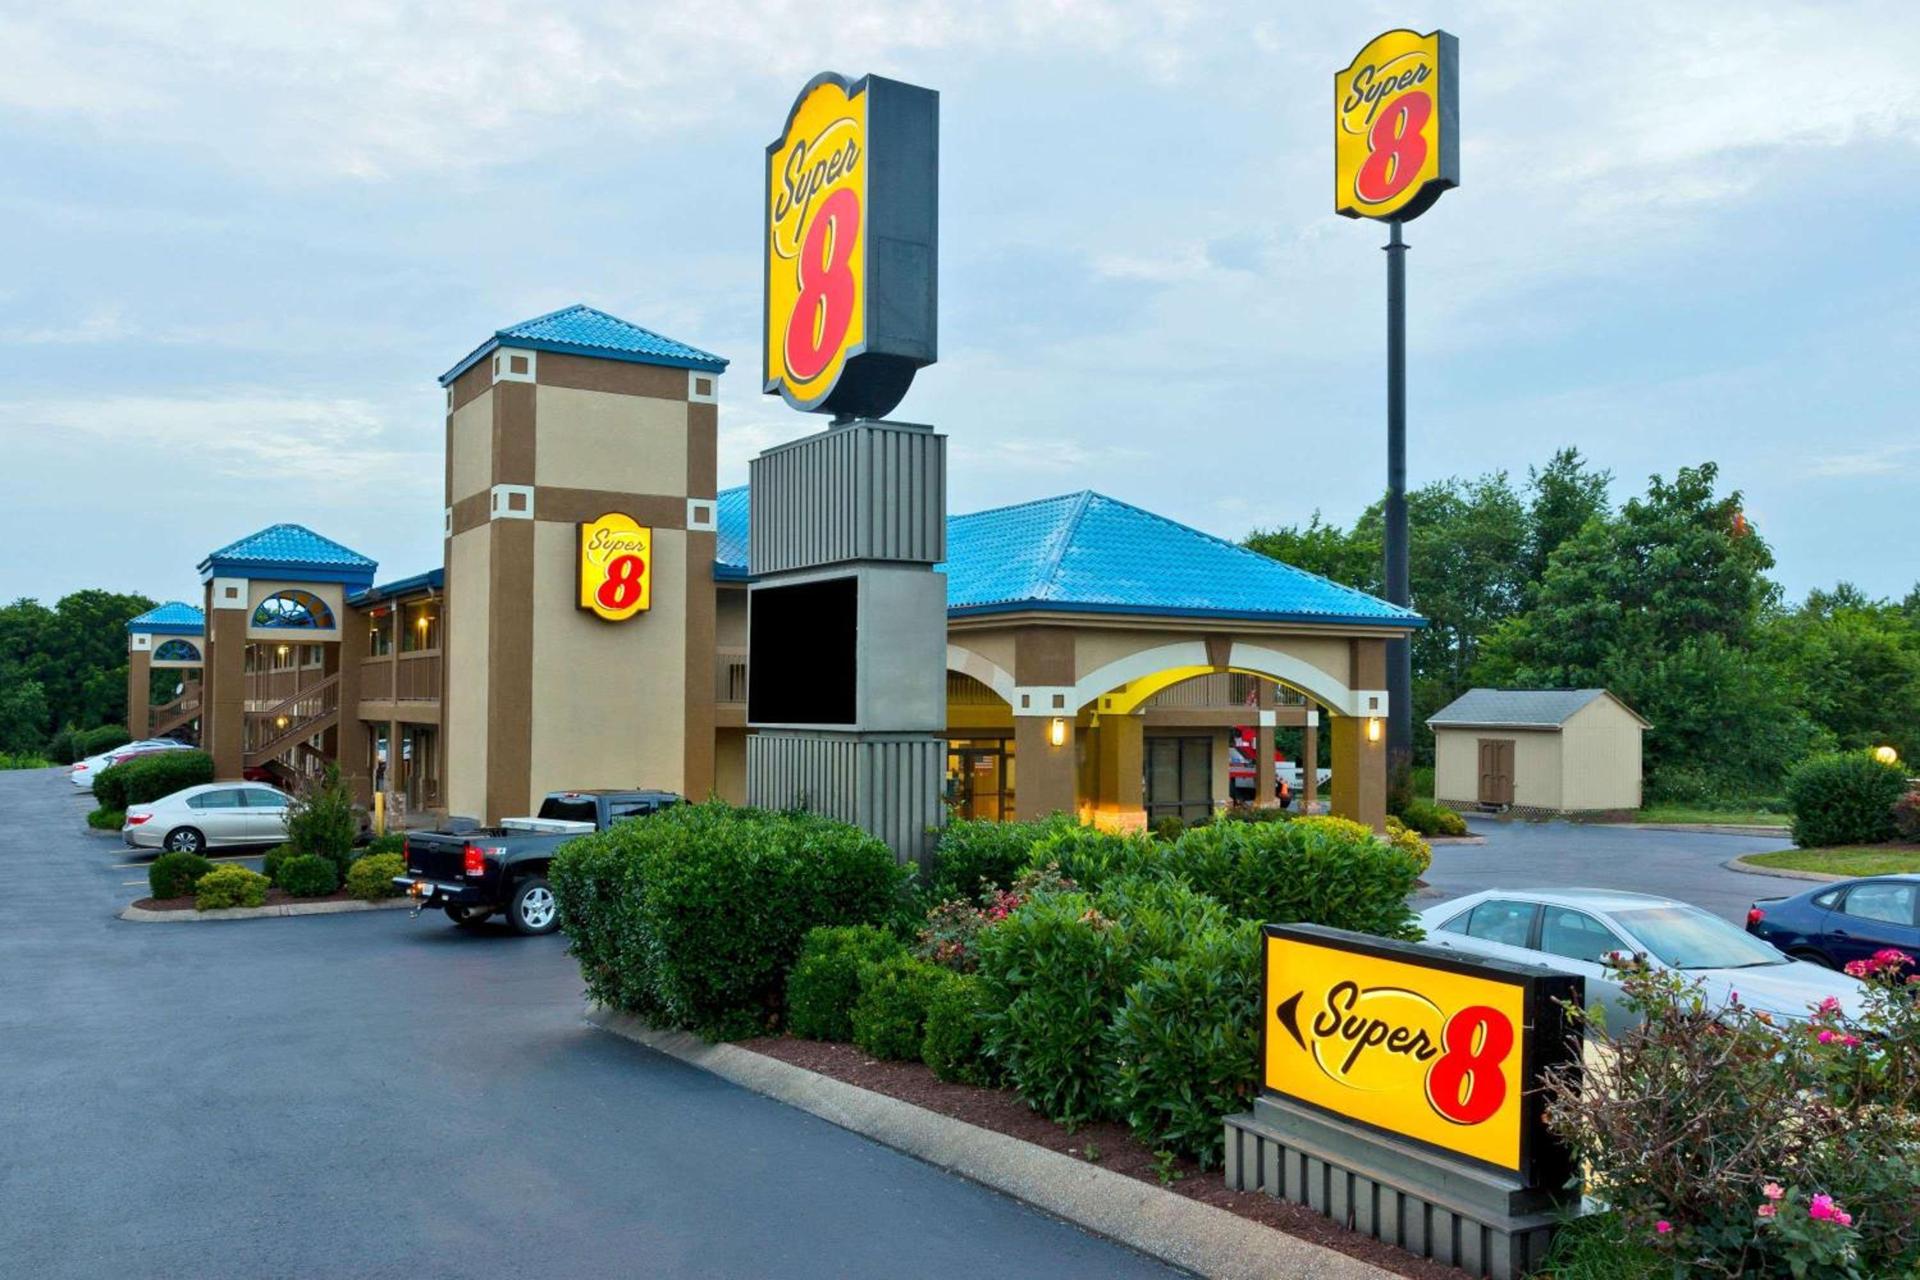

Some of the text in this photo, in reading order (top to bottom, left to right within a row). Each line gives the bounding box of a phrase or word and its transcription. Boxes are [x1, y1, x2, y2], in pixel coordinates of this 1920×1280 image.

[1343, 62, 1433, 125] Super
[774, 137, 860, 244] Super
[1354, 91, 1432, 205] 8
[784, 187, 861, 385] 8
[588, 528, 646, 562] Super
[594, 554, 646, 611] 8
[1313, 980, 1514, 1126] Super 8
